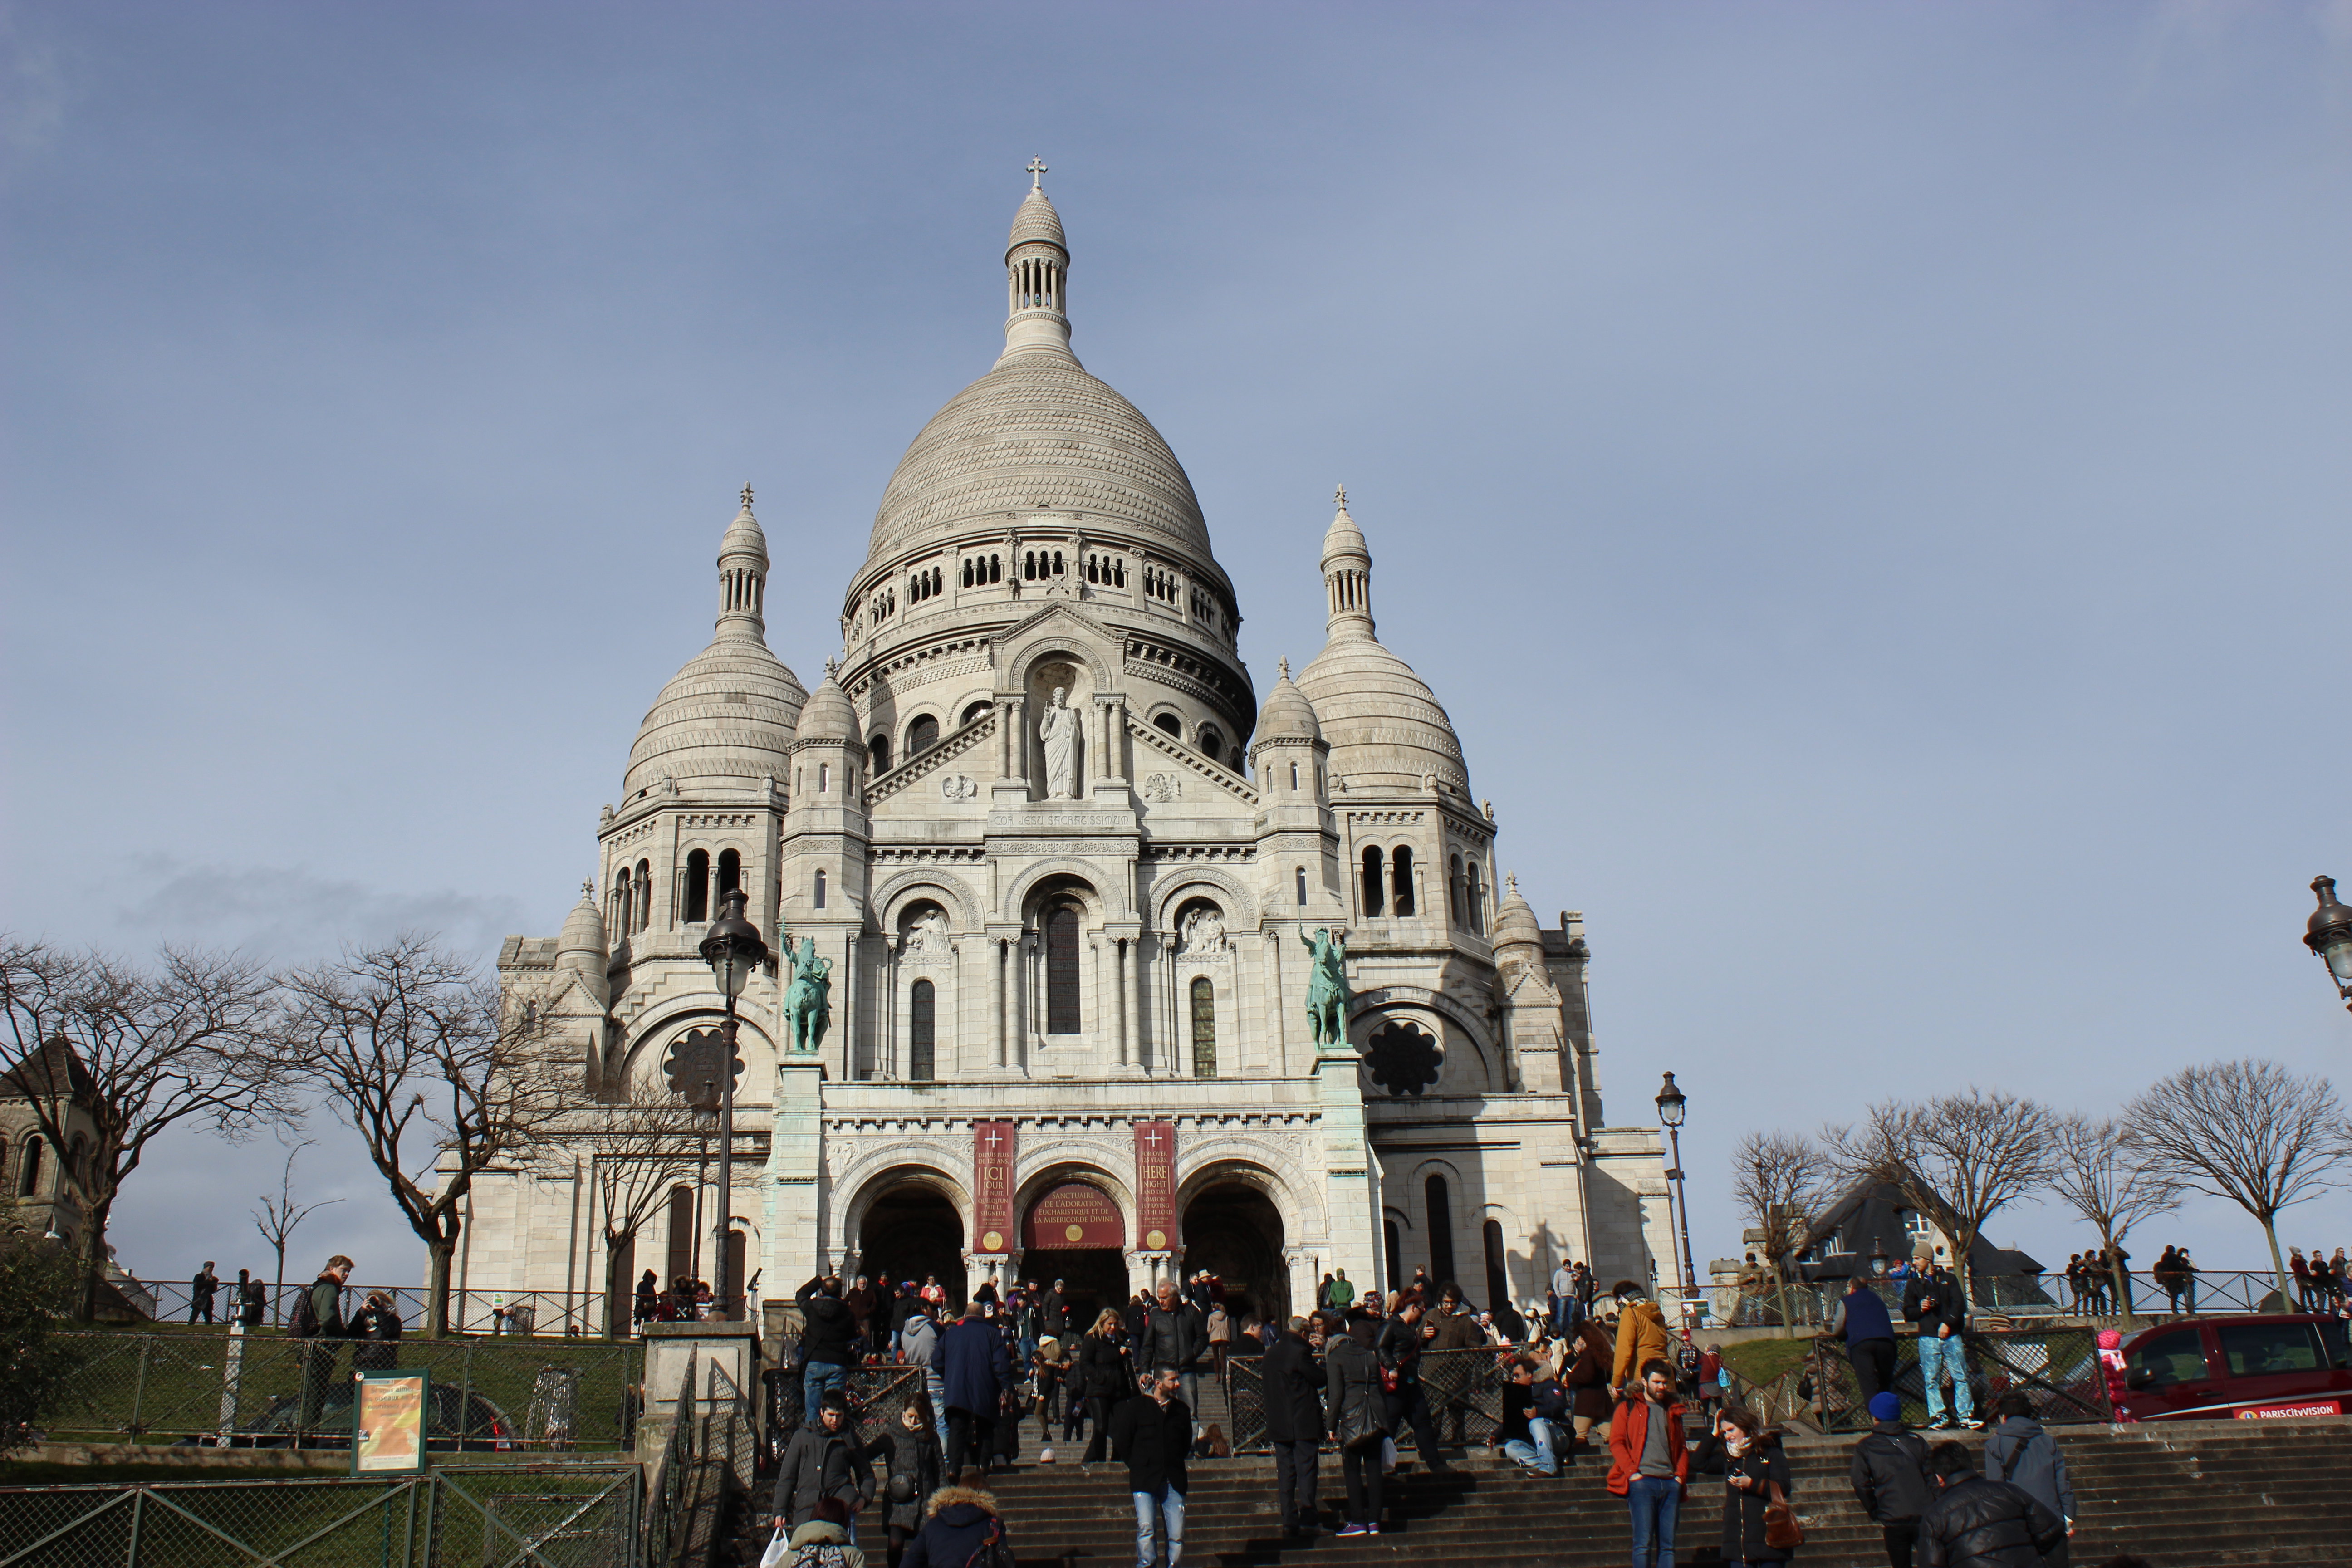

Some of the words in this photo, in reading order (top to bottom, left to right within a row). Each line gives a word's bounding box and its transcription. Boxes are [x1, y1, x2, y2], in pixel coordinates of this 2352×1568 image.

[994, 816, 1014, 825] COR
[1018, 816, 1043, 825] JESU
[1048, 815, 1128, 825] SACRATISSIMUM
[984, 1166, 1003, 1180] ICI
[1143, 1165, 1167, 1179] HERE
[983, 1181, 1004, 1191] JOUR
